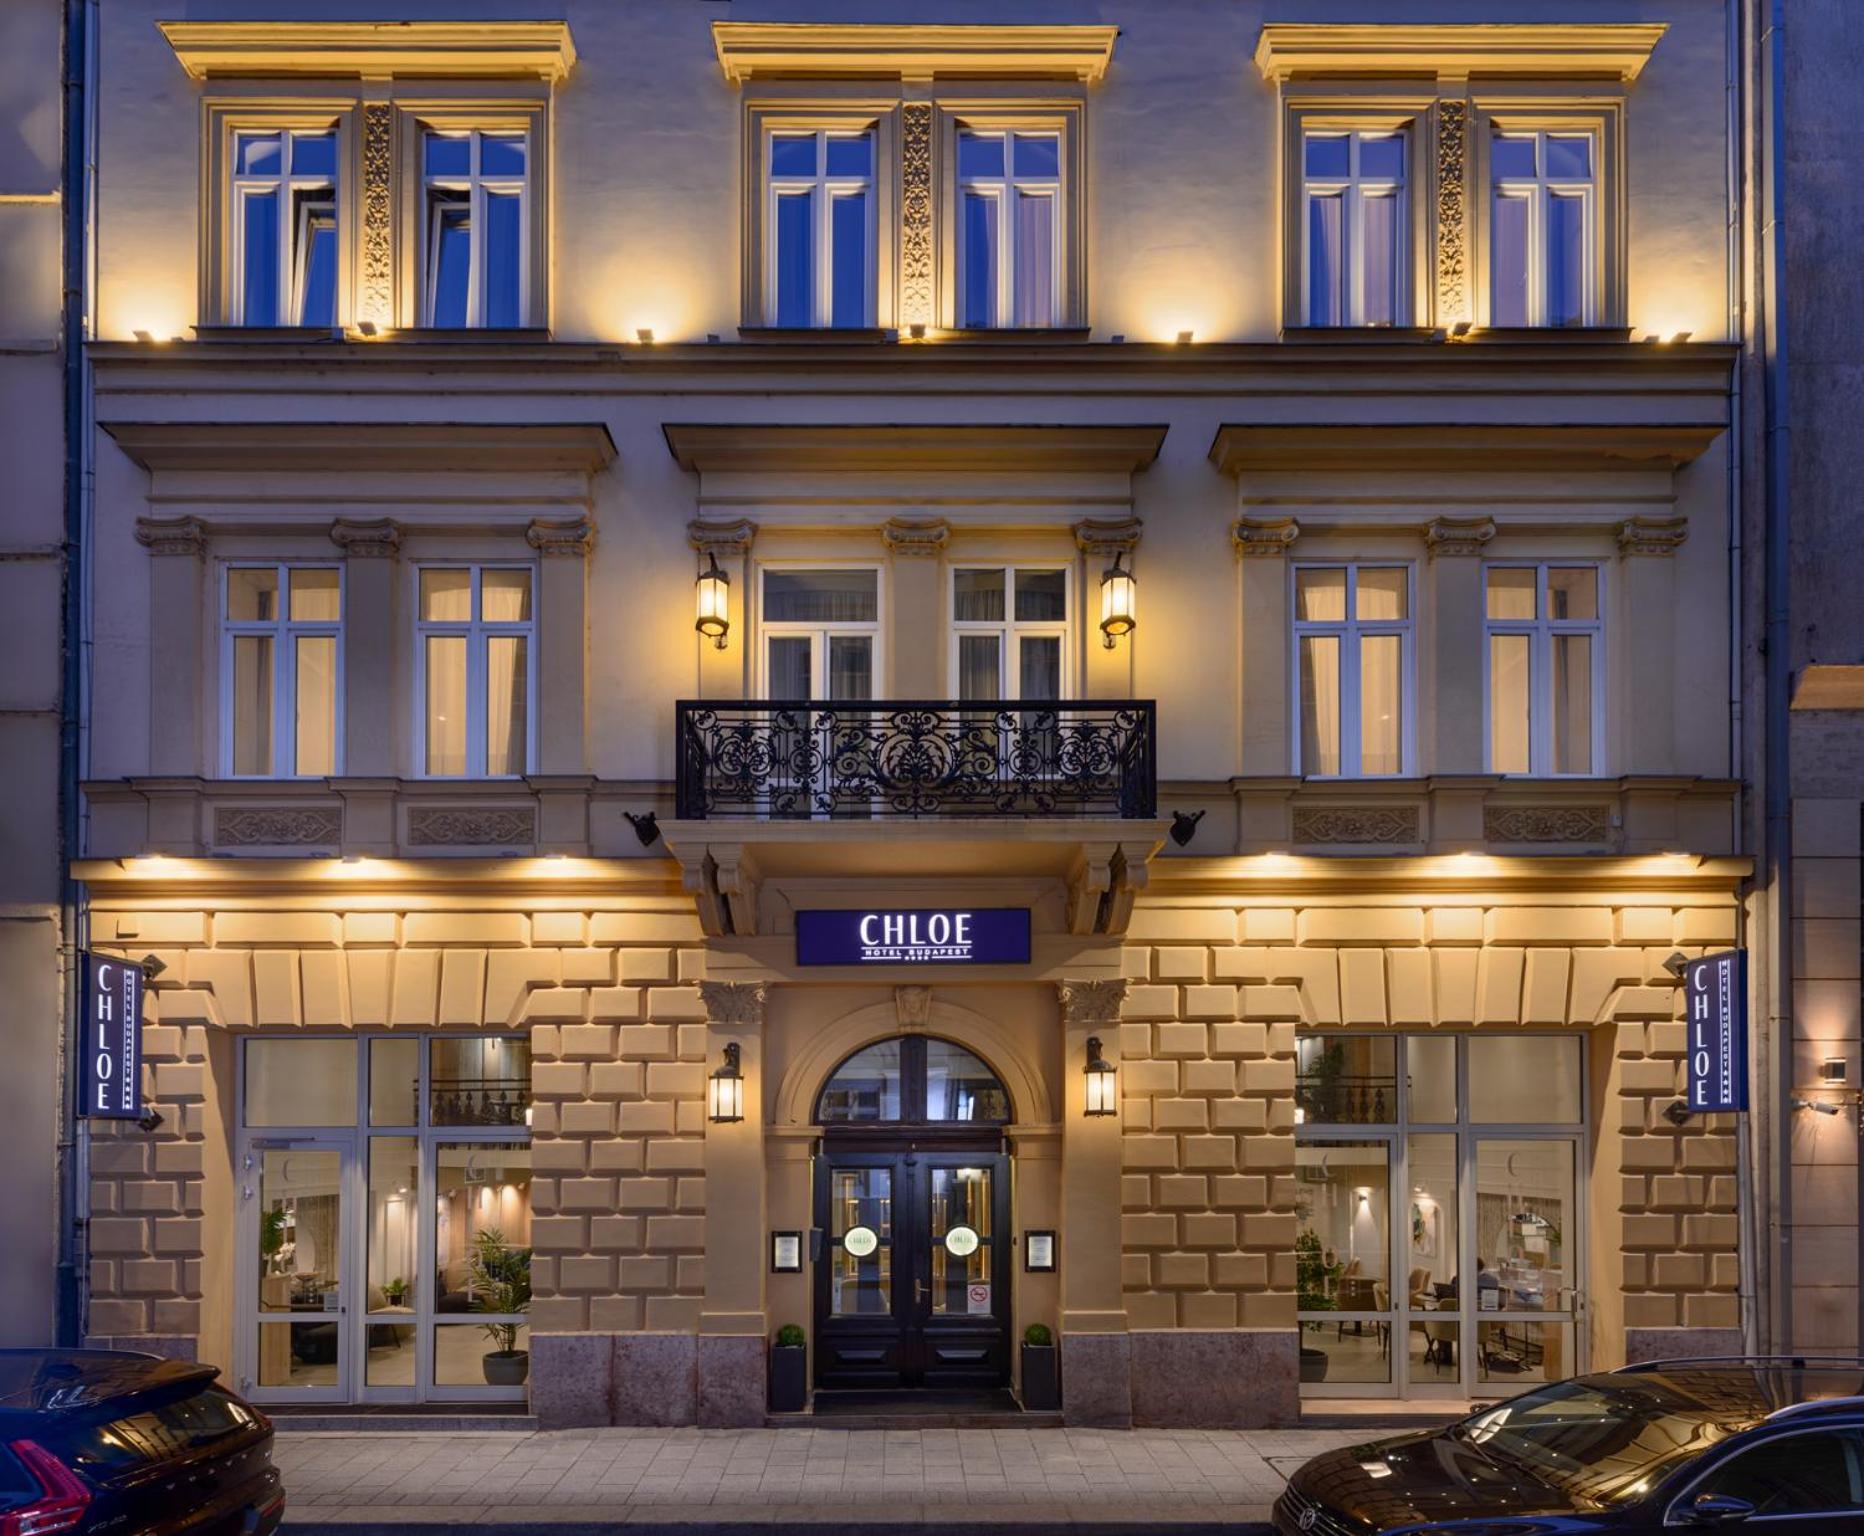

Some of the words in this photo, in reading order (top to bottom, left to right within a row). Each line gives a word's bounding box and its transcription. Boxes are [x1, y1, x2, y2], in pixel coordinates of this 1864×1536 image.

[860, 914, 972, 945] CHLOE
[908, 948, 968, 956] BUDAPEST
[96, 964, 113, 1110] CHLOE
[1694, 964, 1710, 1105] CHLOE
